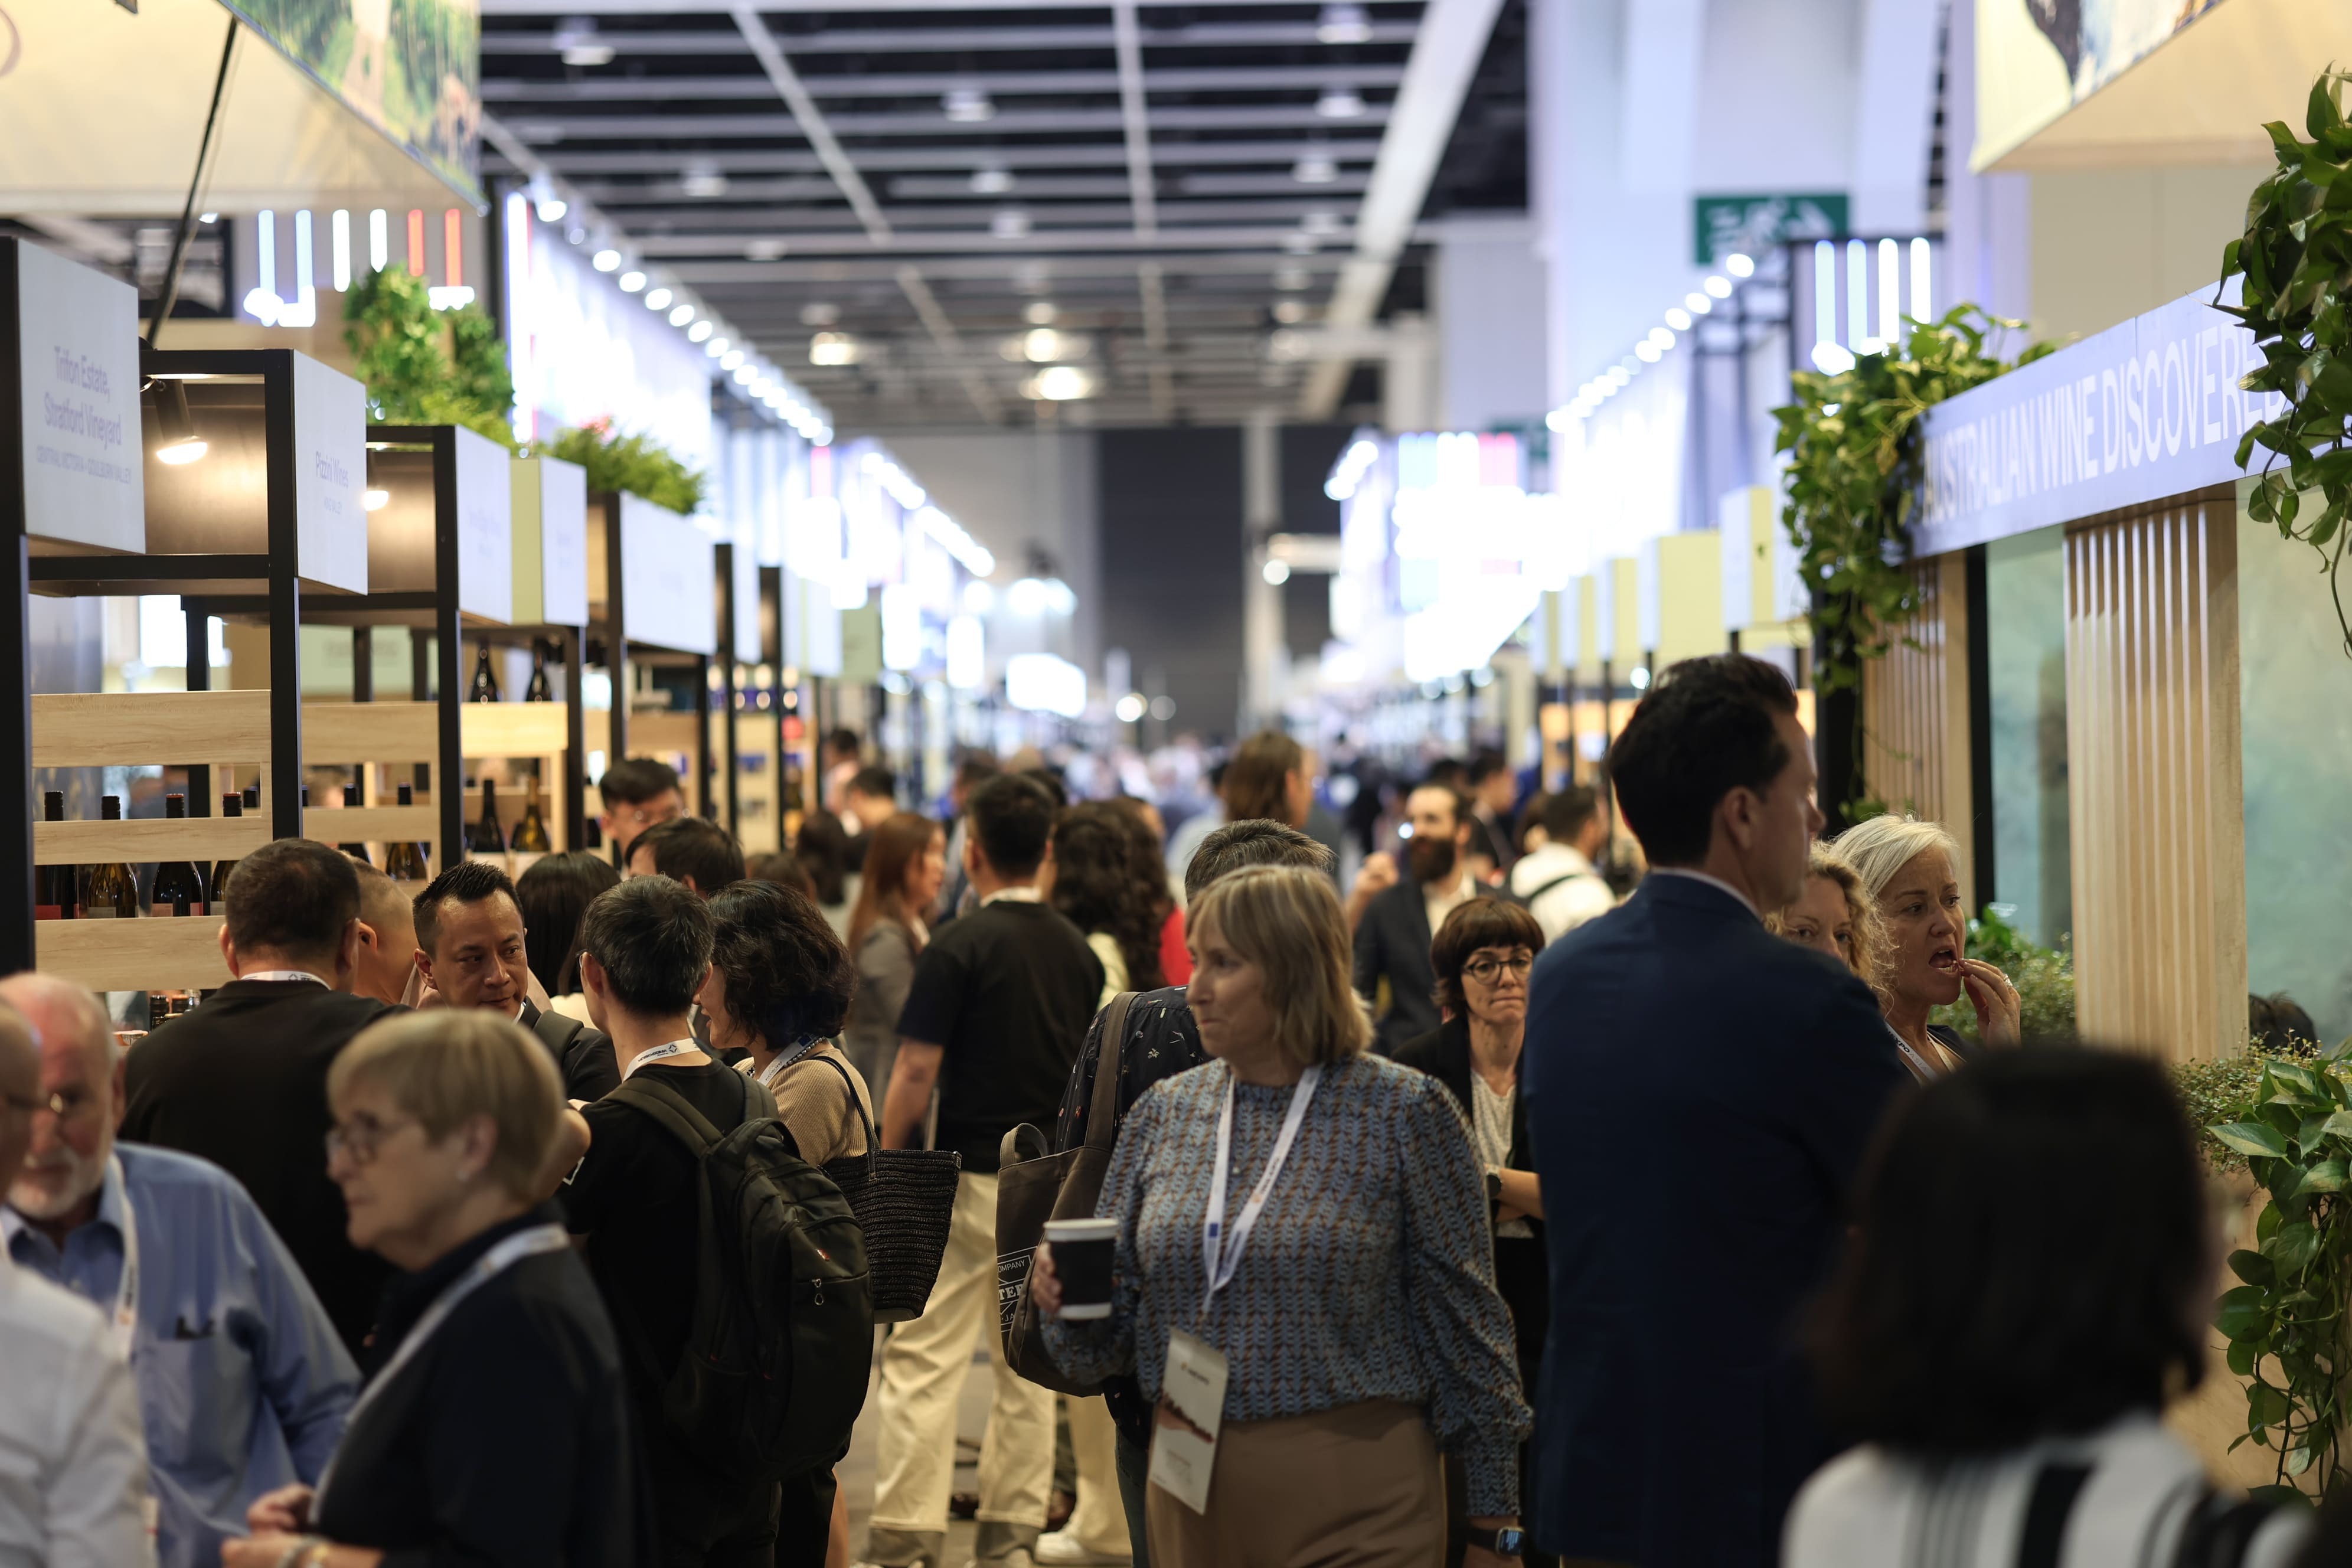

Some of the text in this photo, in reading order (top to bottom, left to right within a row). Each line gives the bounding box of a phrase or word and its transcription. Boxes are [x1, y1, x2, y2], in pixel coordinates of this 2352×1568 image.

[44, 391, 122, 450] Stratford Vineyard
[2037, 374, 2099, 492] WINE
[997, 1259, 1025, 1273] OMPANY
